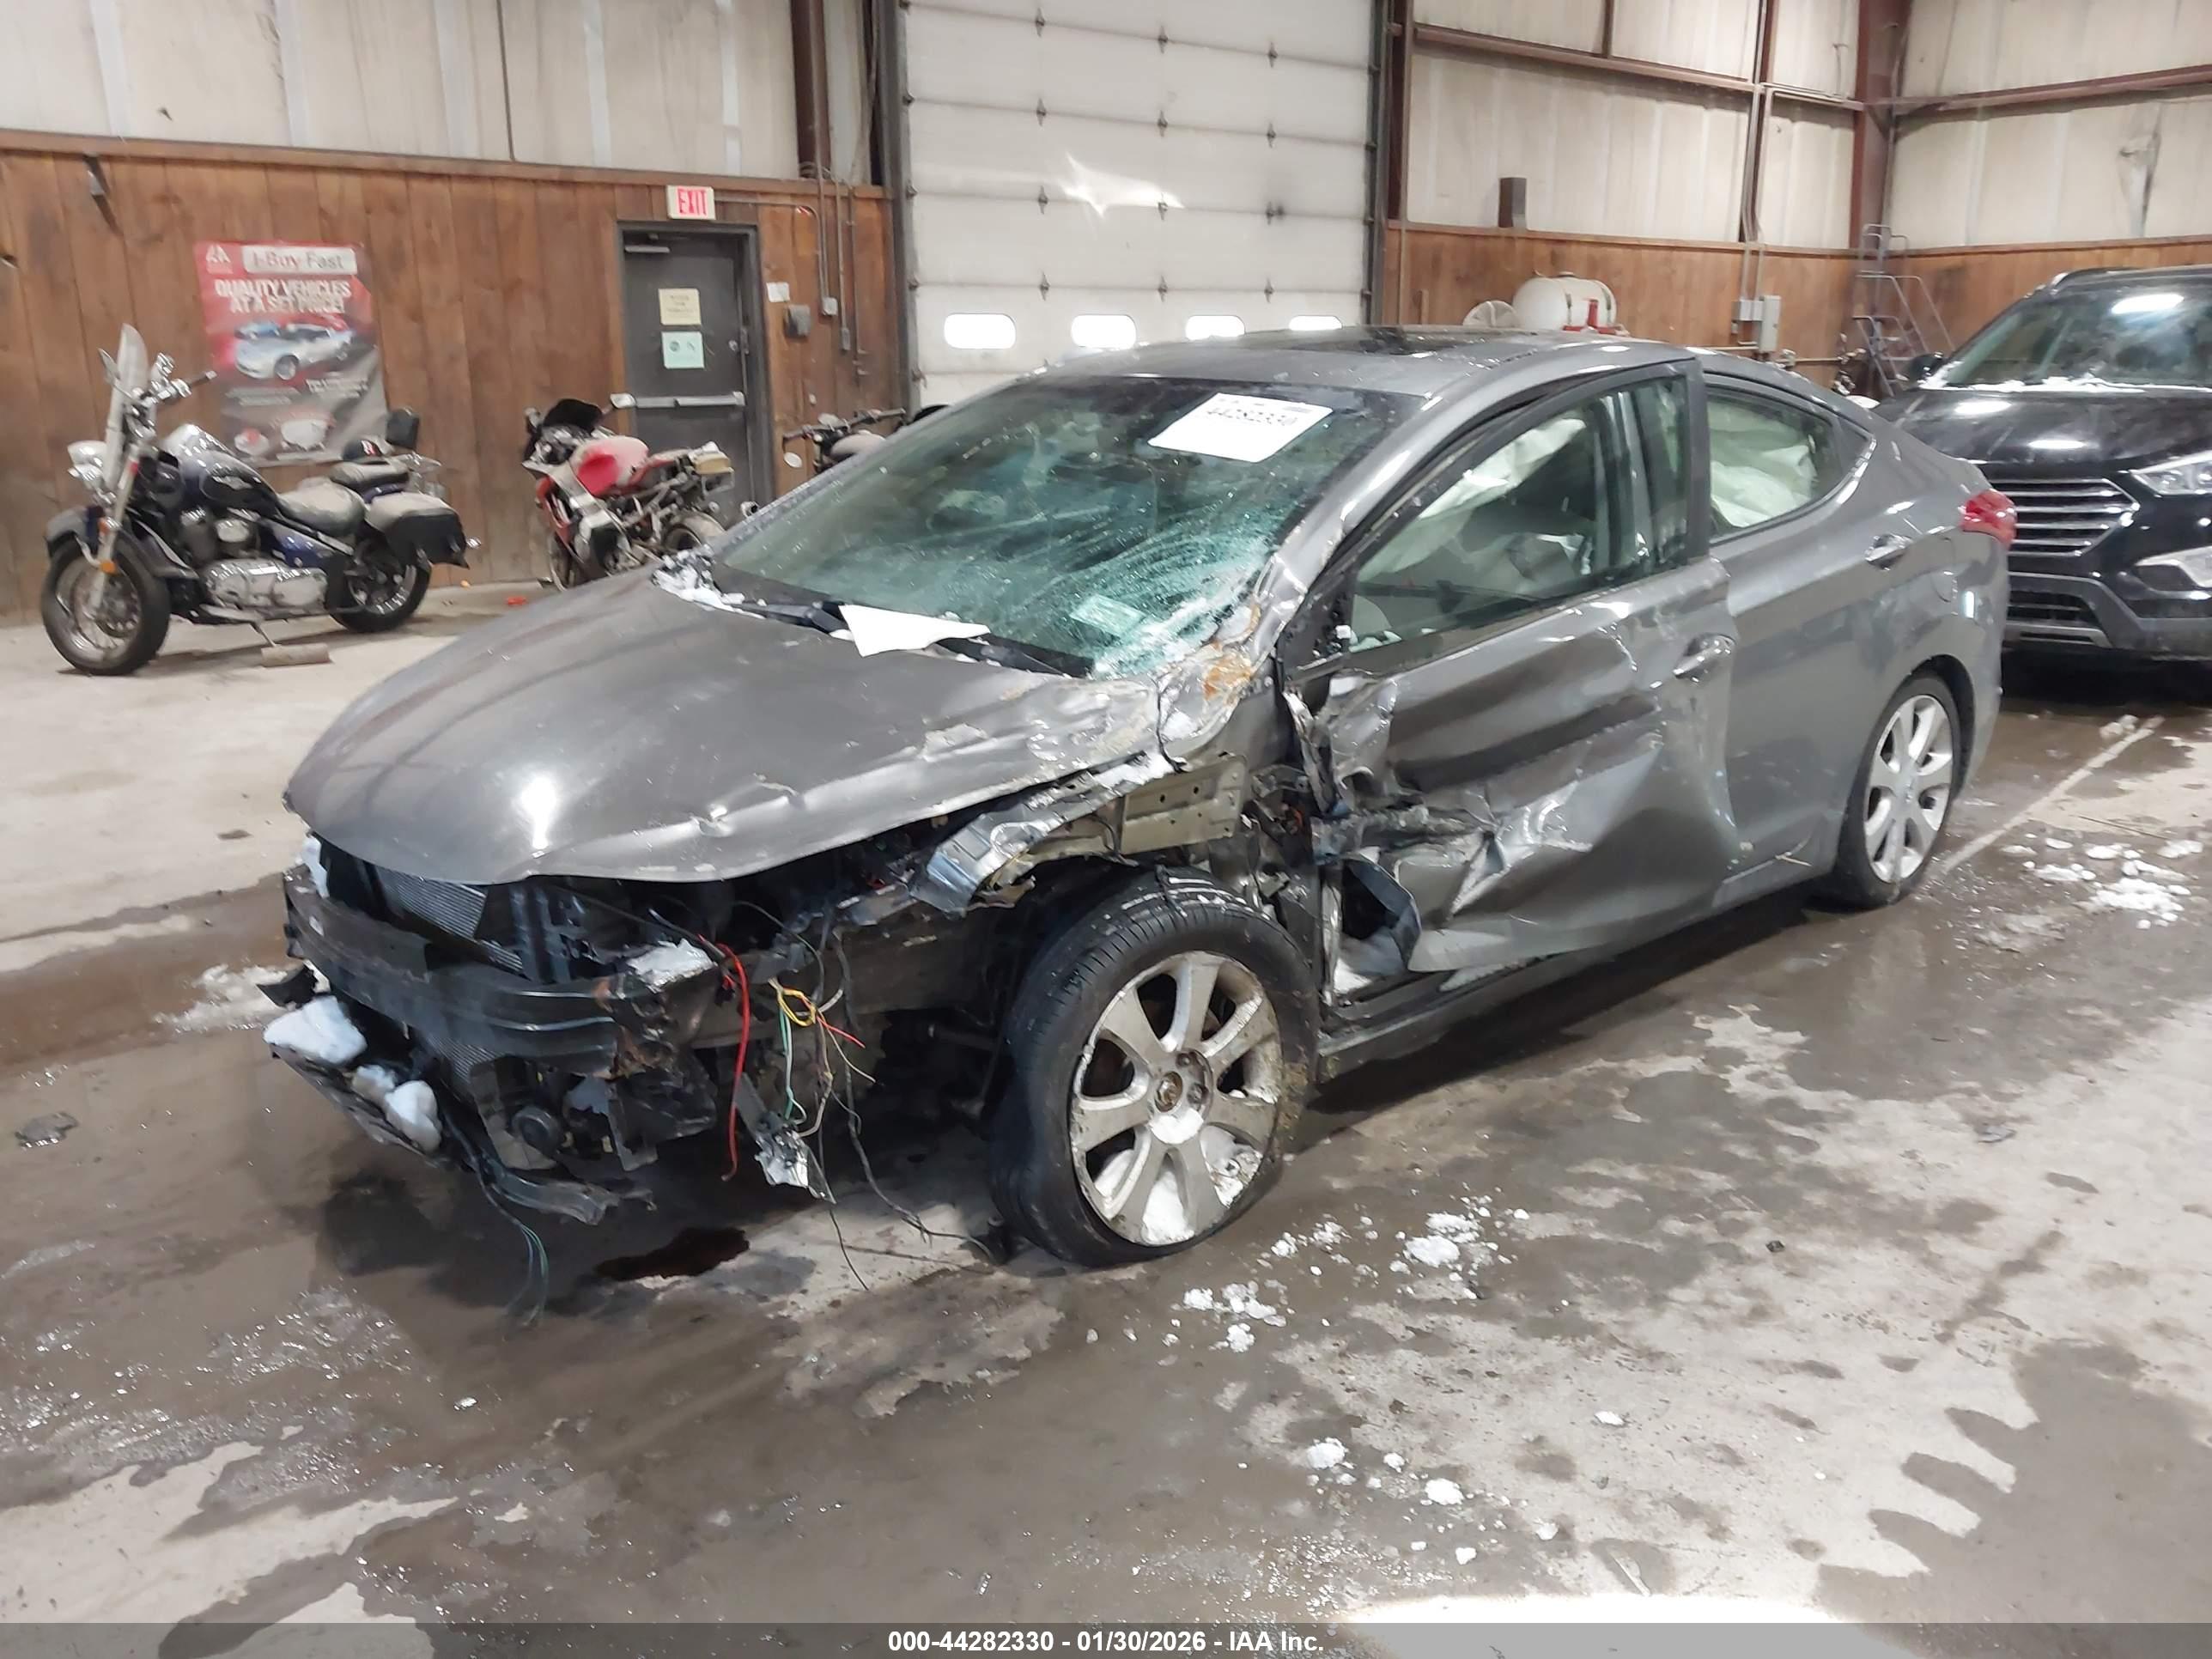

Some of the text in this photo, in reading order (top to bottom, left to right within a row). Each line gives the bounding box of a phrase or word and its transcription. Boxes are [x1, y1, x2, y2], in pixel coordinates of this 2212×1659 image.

[677, 188, 707, 216] EXIT
[306, 251, 344, 270] Fast
[215, 279, 352, 298] QUALITY VEHICLES
[230, 296, 250, 313] AT
[267, 296, 298, 313] SET
